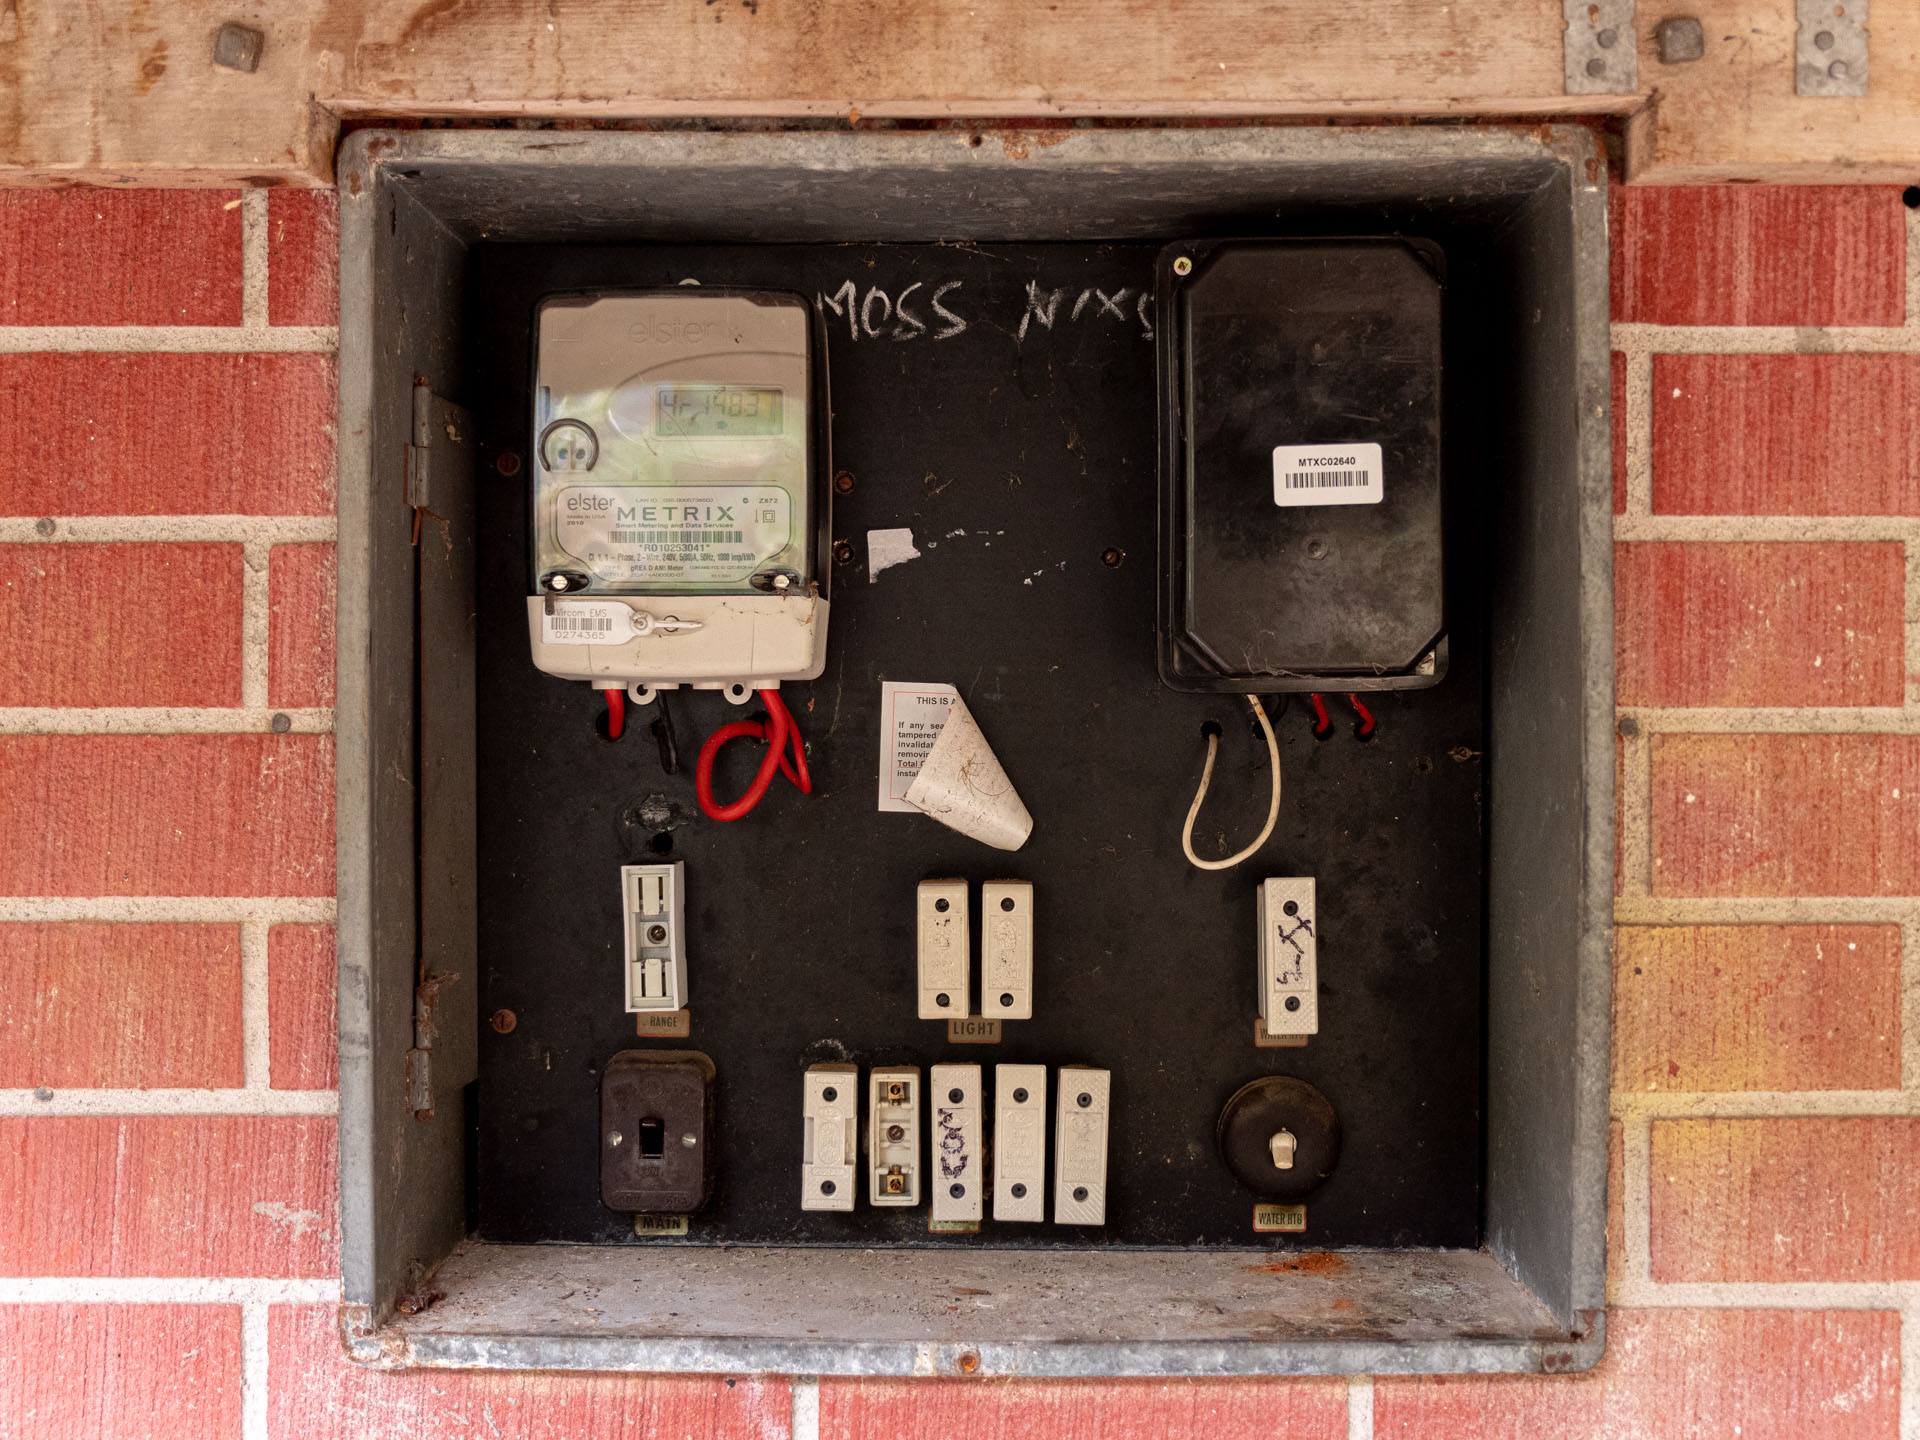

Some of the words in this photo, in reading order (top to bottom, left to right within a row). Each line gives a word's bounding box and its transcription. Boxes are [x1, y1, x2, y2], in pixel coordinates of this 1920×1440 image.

[817, 279, 967, 342] MOSS
[1298, 456, 1356, 467] MTXC02640
[567, 492, 615, 511] elster
[617, 506, 735, 521] METRIX
[589, 608, 608, 617] EMS
[555, 630, 606, 640] 0274365
[916, 696, 937, 705] THIS
[939, 697, 949, 705] IS
[898, 721, 905, 729] If
[898, 731, 937, 740] tampered
[897, 759, 918, 768] Total
[650, 1016, 679, 1027] RANGE
[953, 1022, 995, 1035] LIGHT
[642, 1215, 681, 1229] MAIN
[1258, 1212, 1286, 1225] WATER
